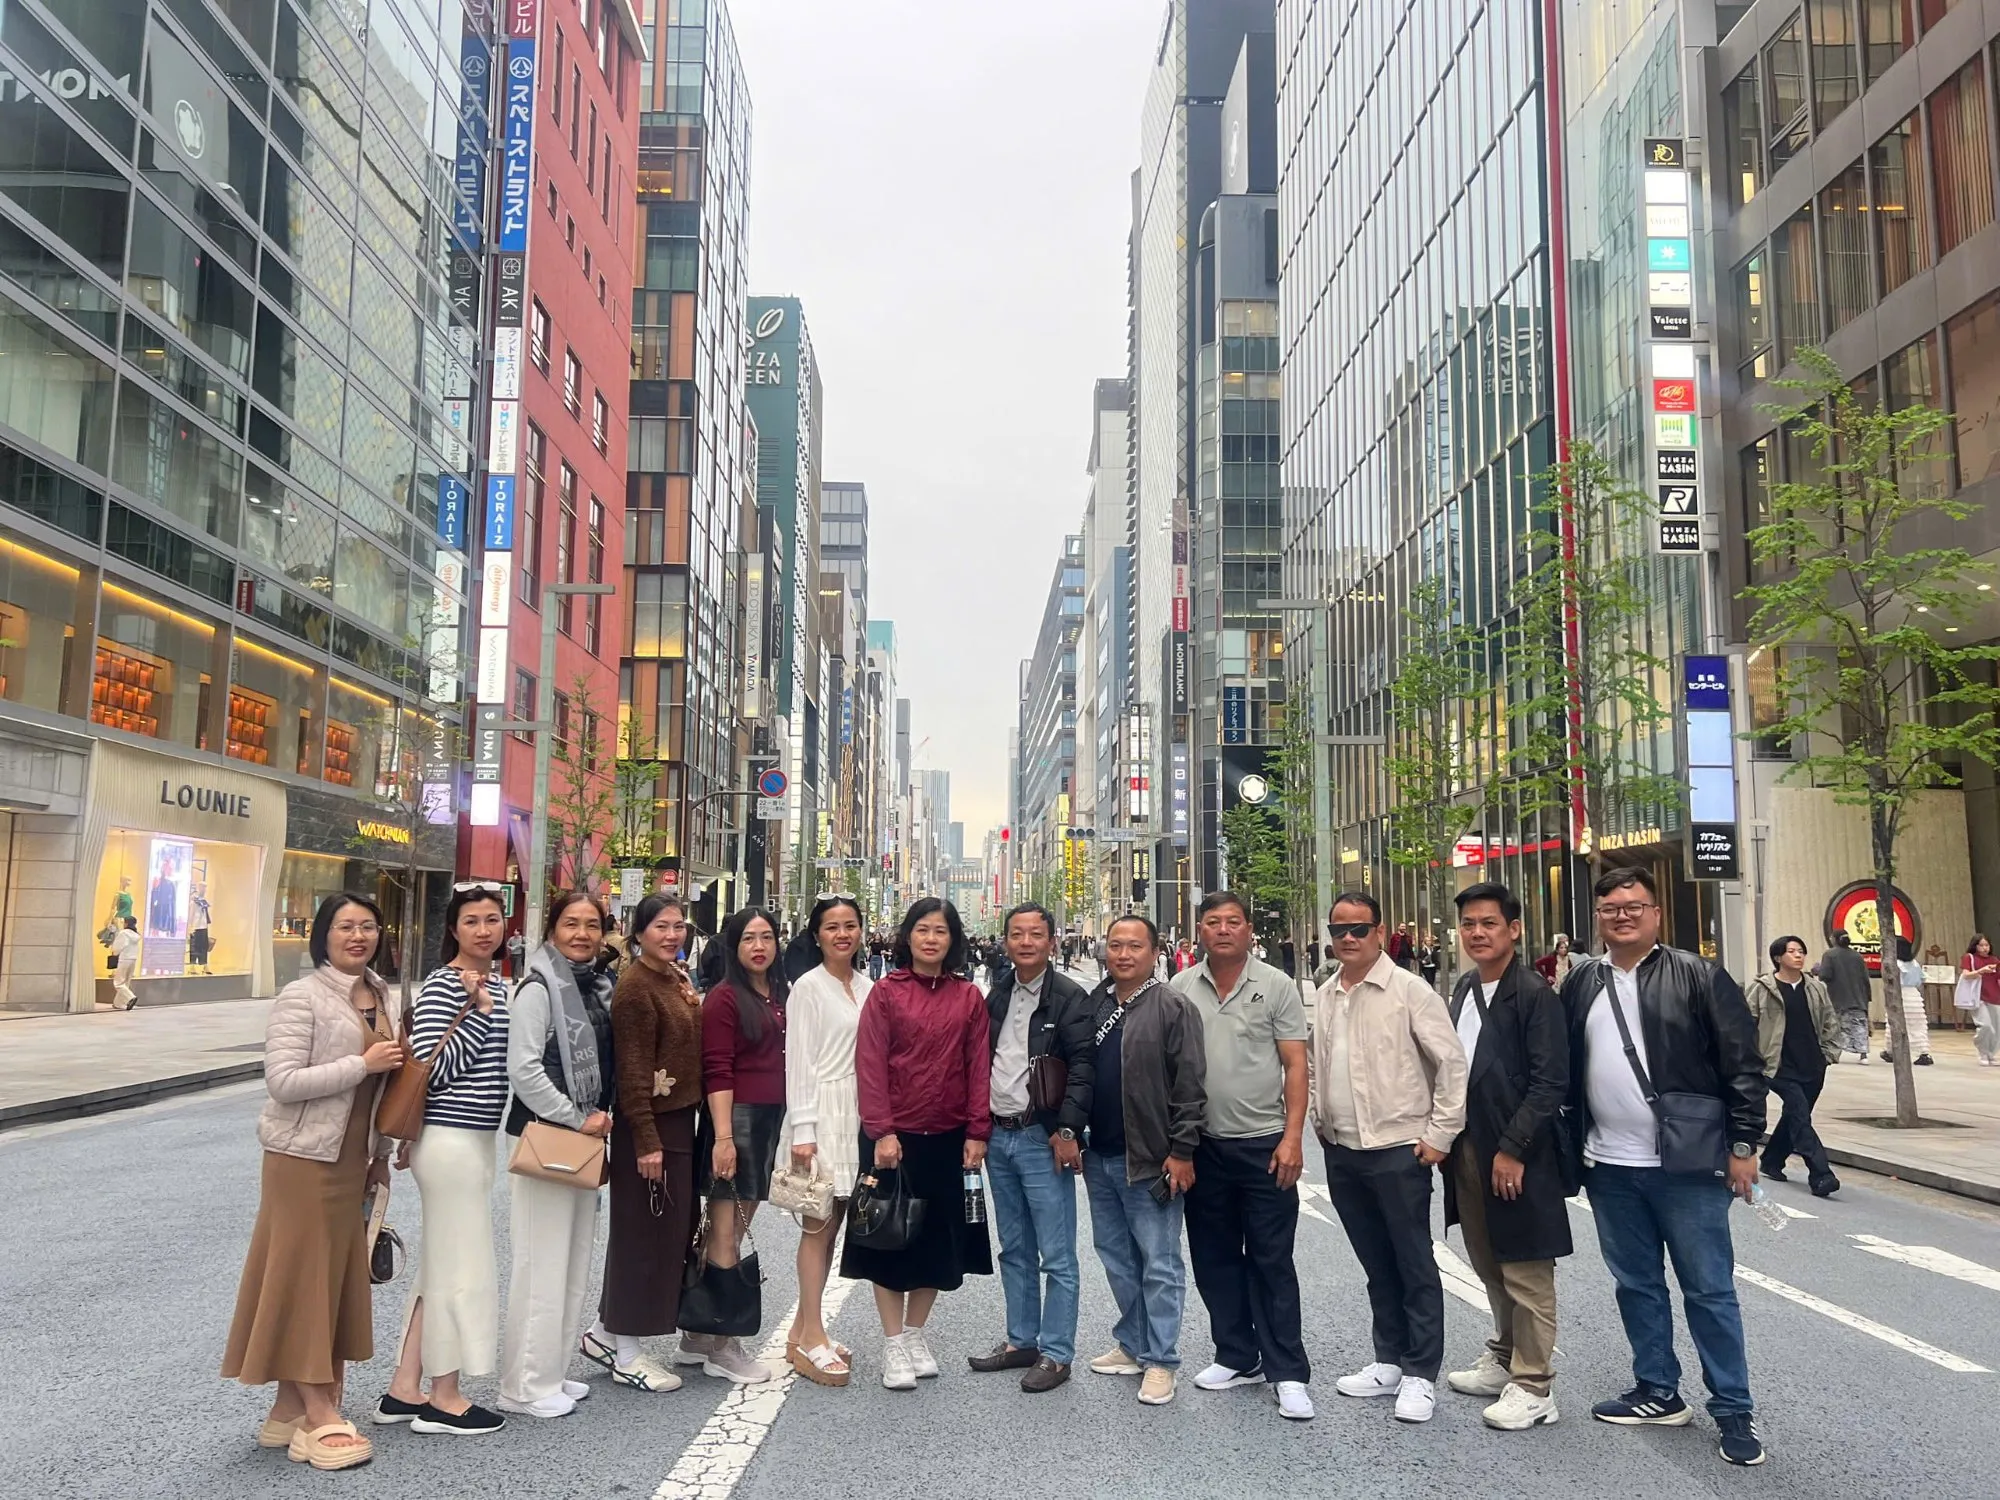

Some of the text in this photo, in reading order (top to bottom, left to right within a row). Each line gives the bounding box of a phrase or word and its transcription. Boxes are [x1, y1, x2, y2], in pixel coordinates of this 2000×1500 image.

[514, 1, 535, 34] ビル
[503, 84, 531, 235] スペーストラスト
[501, 286, 519, 309] AK
[1653, 315, 1688, 325] Valette
[1659, 456, 1694, 464] GINZA
[1659, 463, 1695, 474] RASIN
[493, 480, 507, 545] TORAIZ
[1662, 526, 1698, 534] GINZA
[1662, 533, 1698, 544] RASIN
[748, 598, 759, 643] OTSUKA
[747, 653, 758, 692] YAMADA
[1175, 643, 1185, 696] MONTBLANC
[482, 711, 496, 760] SUNA
[160, 780, 252, 819] LOUNIE
[1174, 768, 1187, 821] 日新堂
[1627, 827, 1661, 847] RASIN
[571, 1046, 595, 1065] RIS
